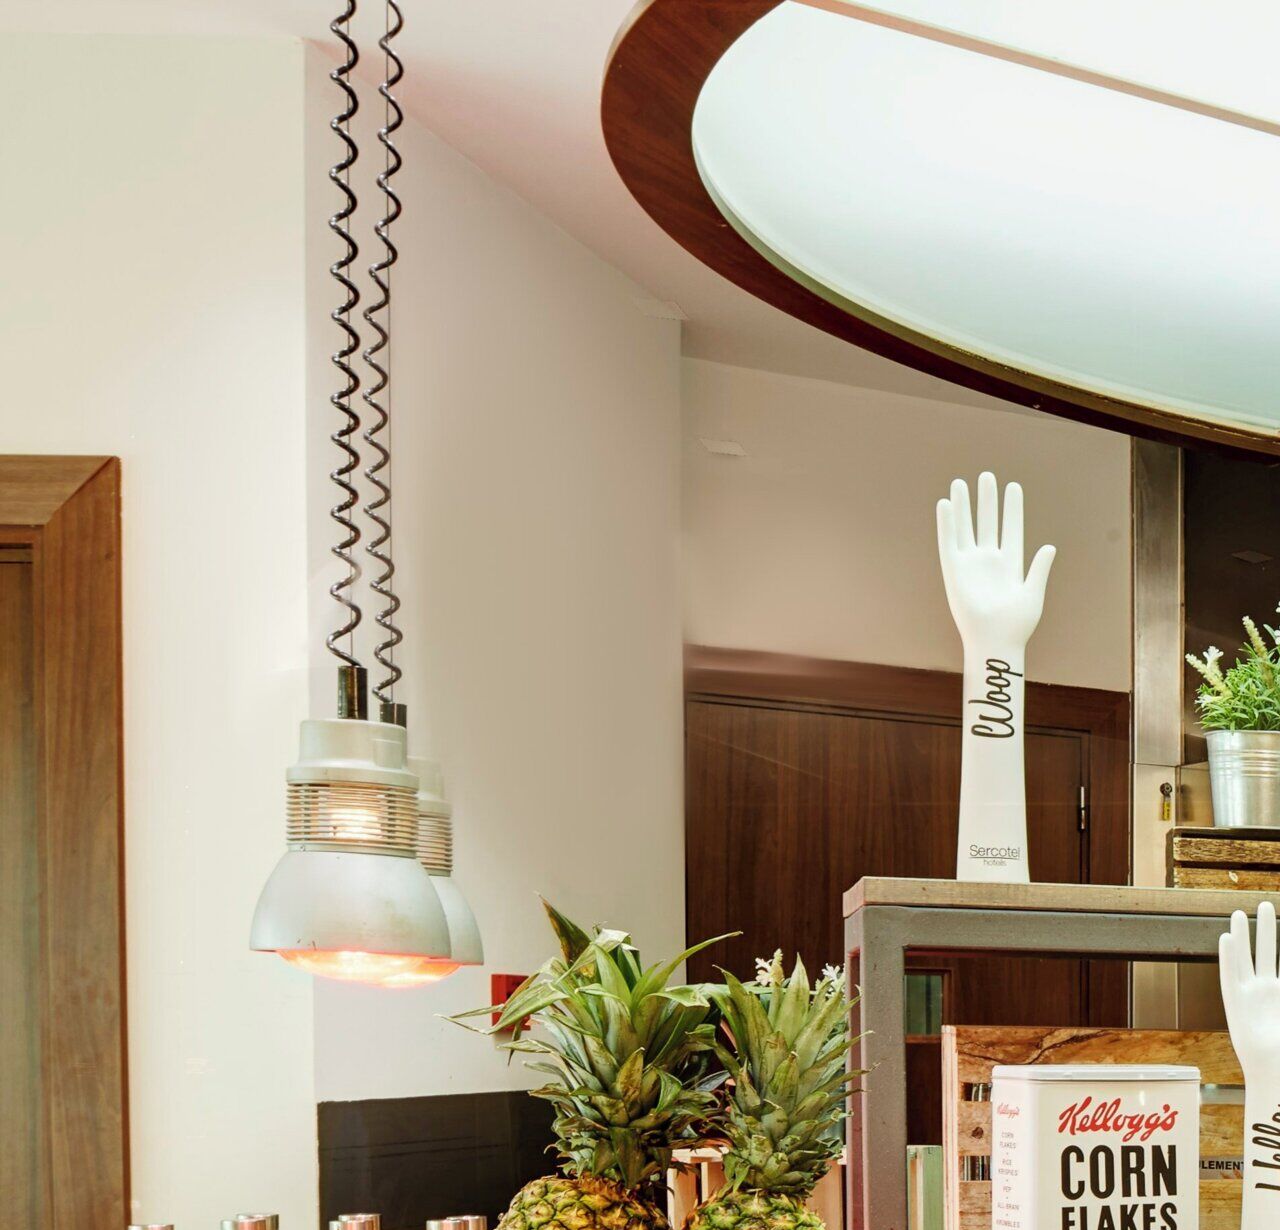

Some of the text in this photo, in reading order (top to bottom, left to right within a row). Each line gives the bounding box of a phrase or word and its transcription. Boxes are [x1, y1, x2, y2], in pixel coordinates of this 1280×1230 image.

[968, 658, 1023, 738] Woop
[1058, 1096, 1179, 1142] Kellogg's
[1060, 1144, 1178, 1200] CORN
[1199, 1160, 1244, 1170] LEMEN
